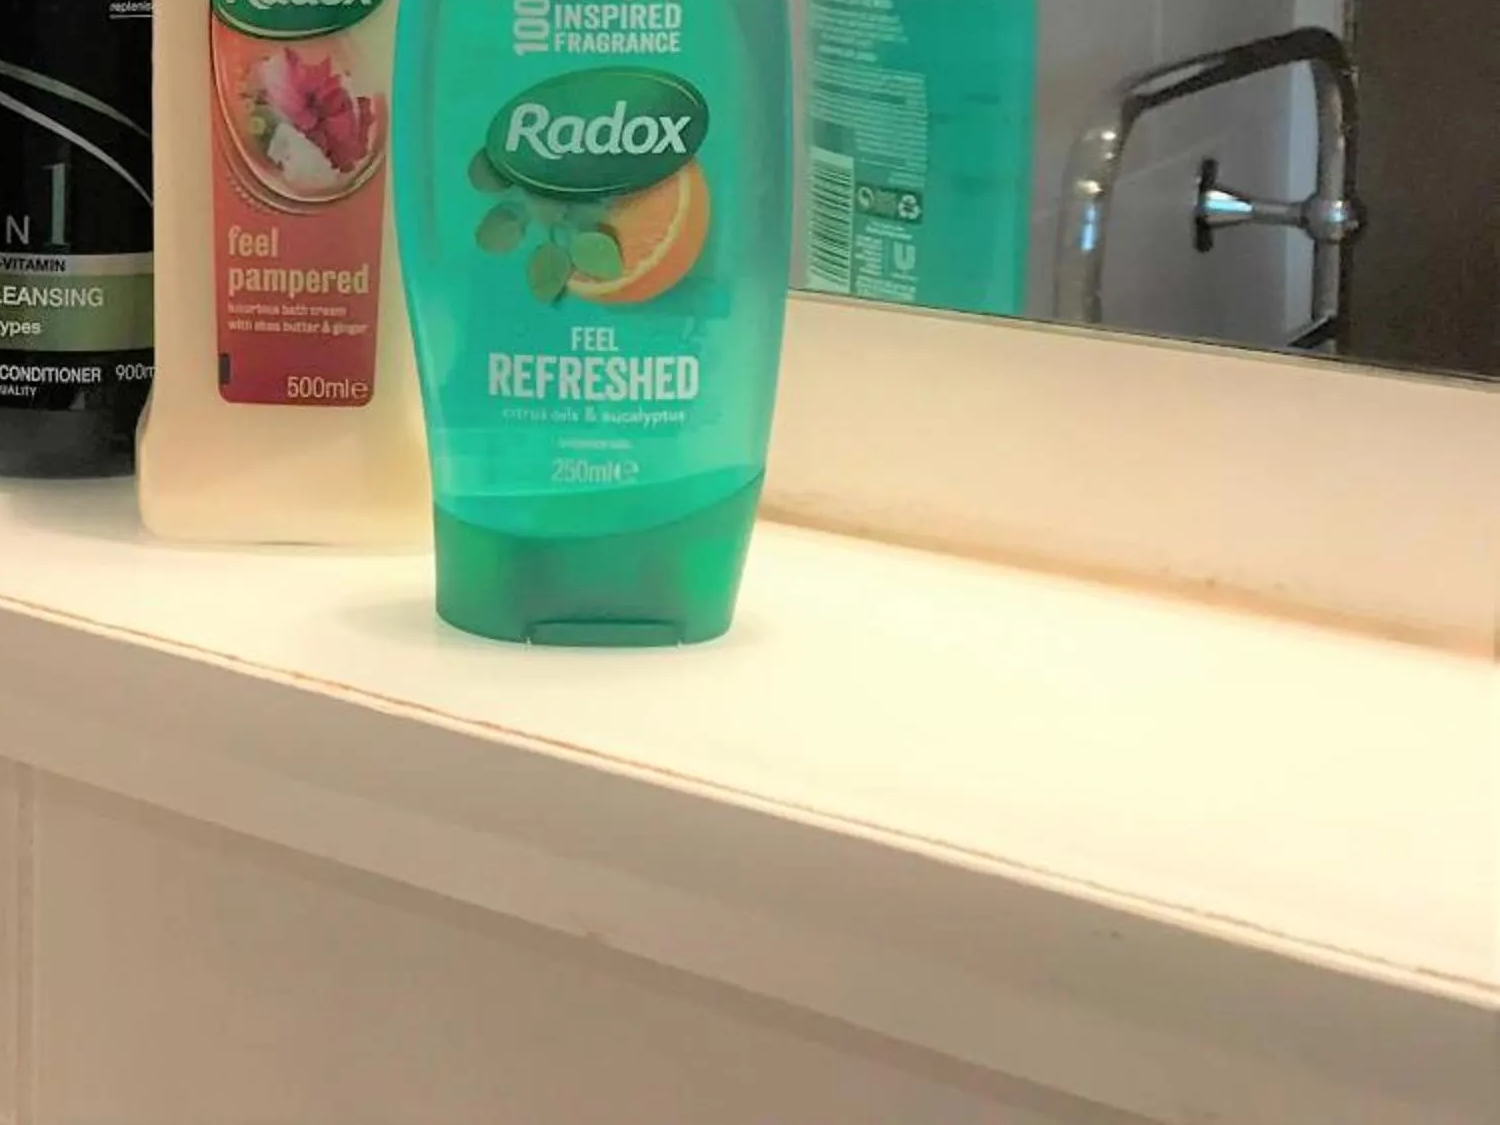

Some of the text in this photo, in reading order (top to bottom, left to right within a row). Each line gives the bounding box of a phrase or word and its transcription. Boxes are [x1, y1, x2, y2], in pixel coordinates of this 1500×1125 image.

[554, 4, 682, 30] INSPIRED
[553, 32, 681, 53] FRAGRANCE
[505, 100, 691, 160] Radox
[42, 163, 69, 246] 1
[227, 226, 278, 257] feel
[228, 264, 369, 299] pampered
[571, 327, 620, 352] FEEL
[115, 364, 157, 381] 900m
[488, 353, 699, 401] REFRESHED
[602, 407, 686, 430] eucalyptus
